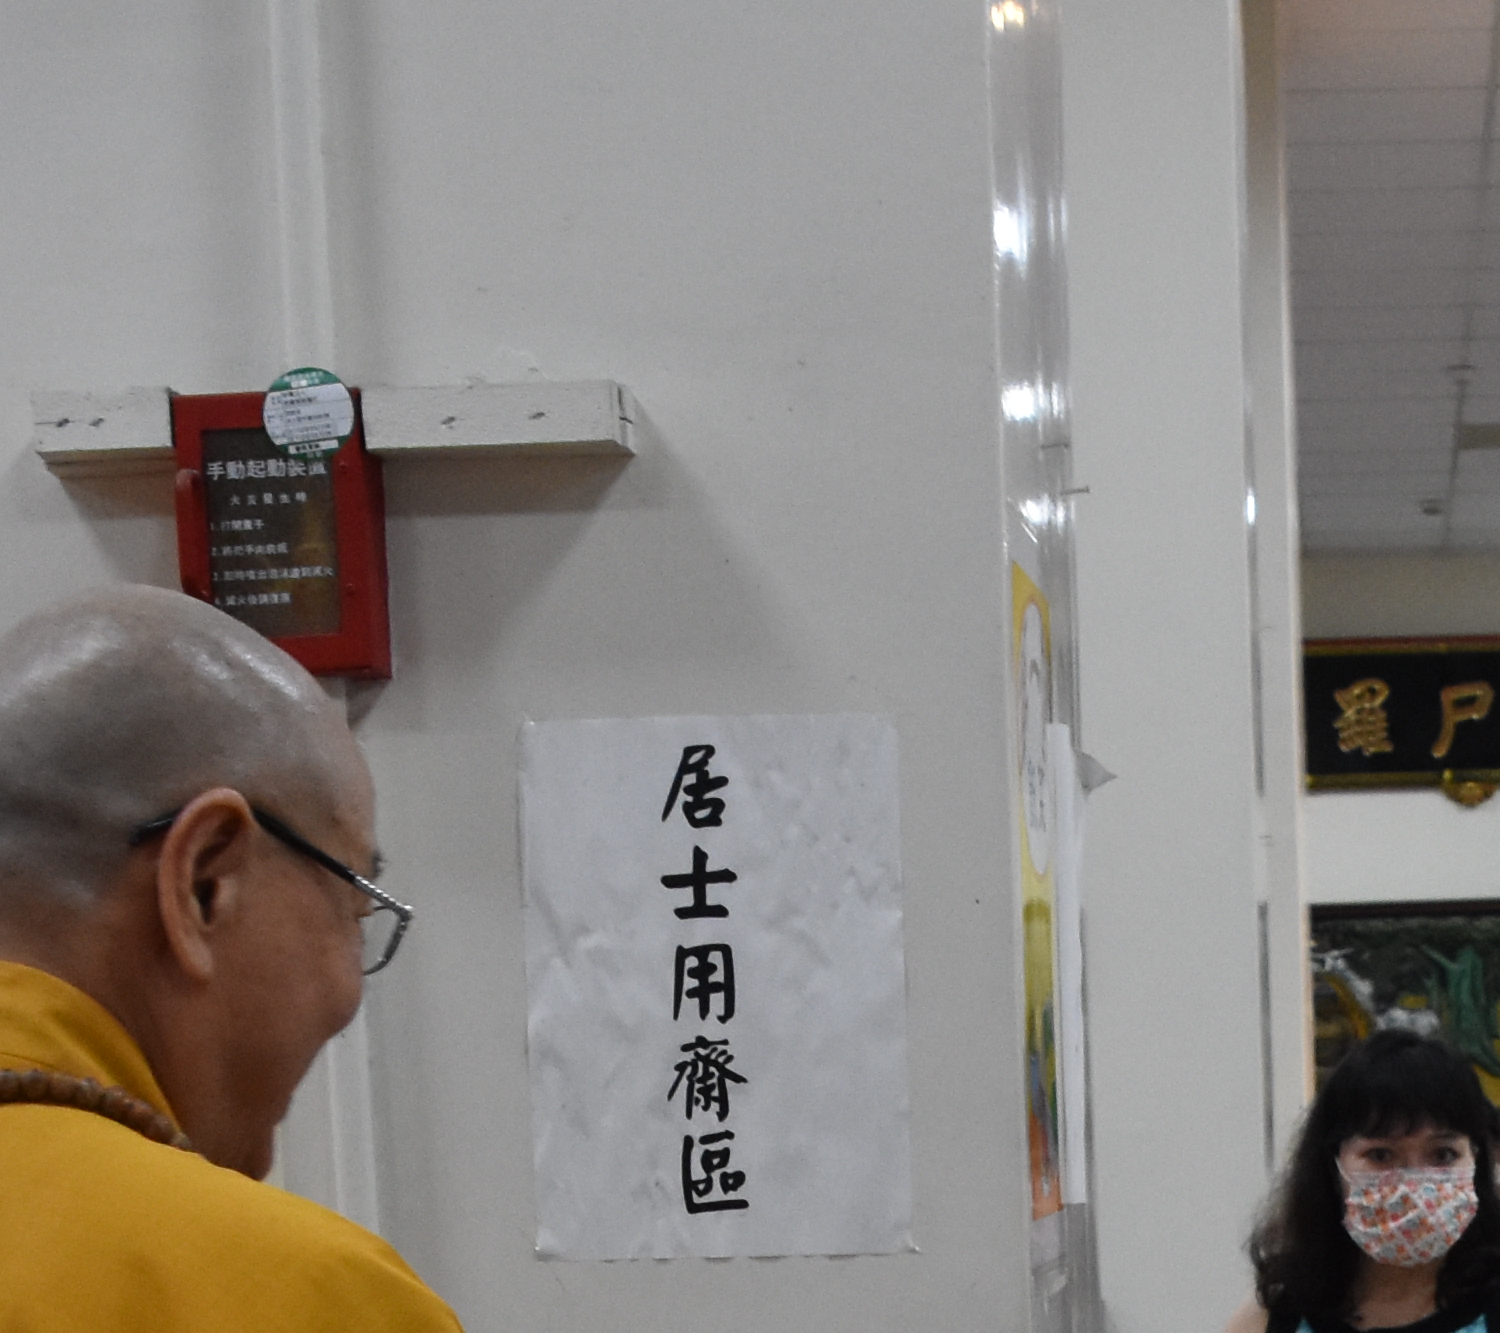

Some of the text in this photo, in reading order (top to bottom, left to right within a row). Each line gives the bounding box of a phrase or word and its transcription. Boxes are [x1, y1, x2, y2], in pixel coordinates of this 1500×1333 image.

[660, 744, 748, 1214] 居士用齋區
